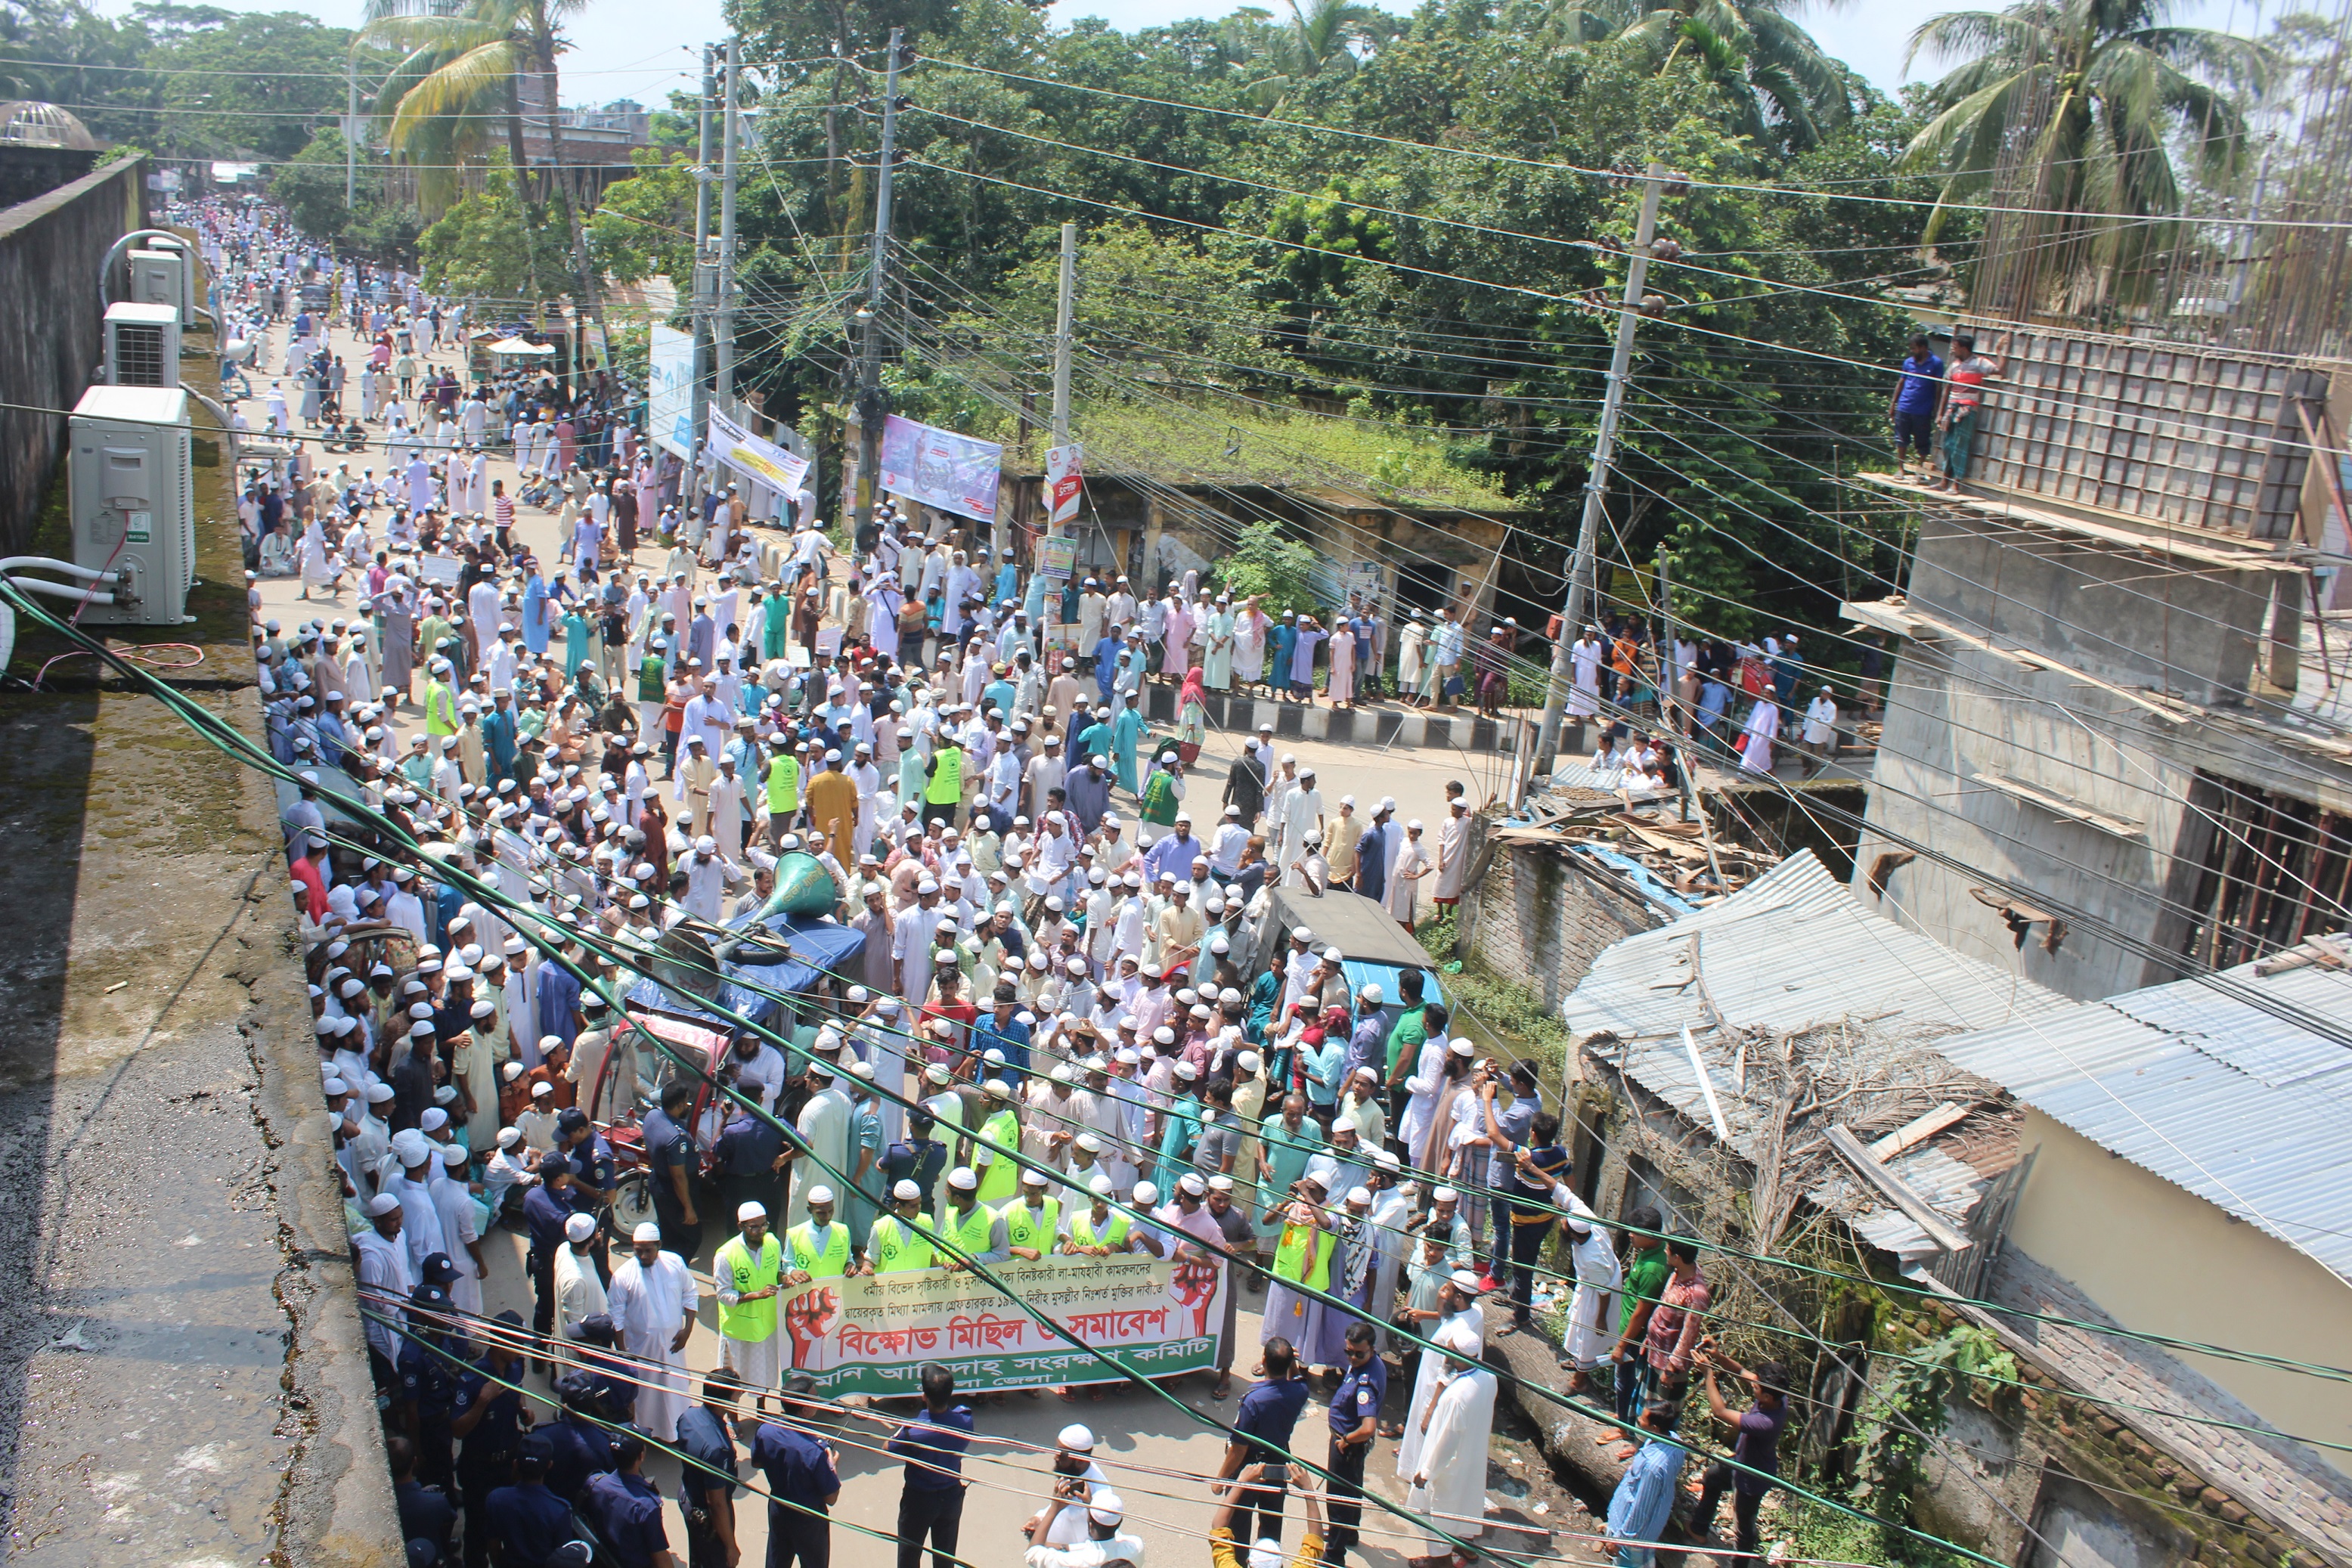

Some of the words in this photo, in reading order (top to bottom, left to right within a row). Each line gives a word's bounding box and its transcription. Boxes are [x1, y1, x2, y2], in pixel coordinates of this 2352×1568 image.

[888, 1280, 913, 1295] বিভেদ
[917, 1274, 950, 1297] সৃষ্টিকারী
[954, 1278, 961, 1288] ও
[1017, 1264, 1055, 1283] বিনষ্টকারী
[1105, 1263, 1151, 1278] কামরুলদের
[888, 1303, 910, 1318] মিথ্যা
[912, 1300, 944, 1316] মামলায়
[1137, 1281, 1164, 1297] দাবীতে
[836, 1324, 941, 1358] বিক্ষোভ
[946, 1313, 1027, 1351] মিছিল
[1066, 1305, 1170, 1341] সমাবেশ
[1130, 1337, 1214, 1362] কমিটি
[993, 1374, 1054, 1387] জেলা
